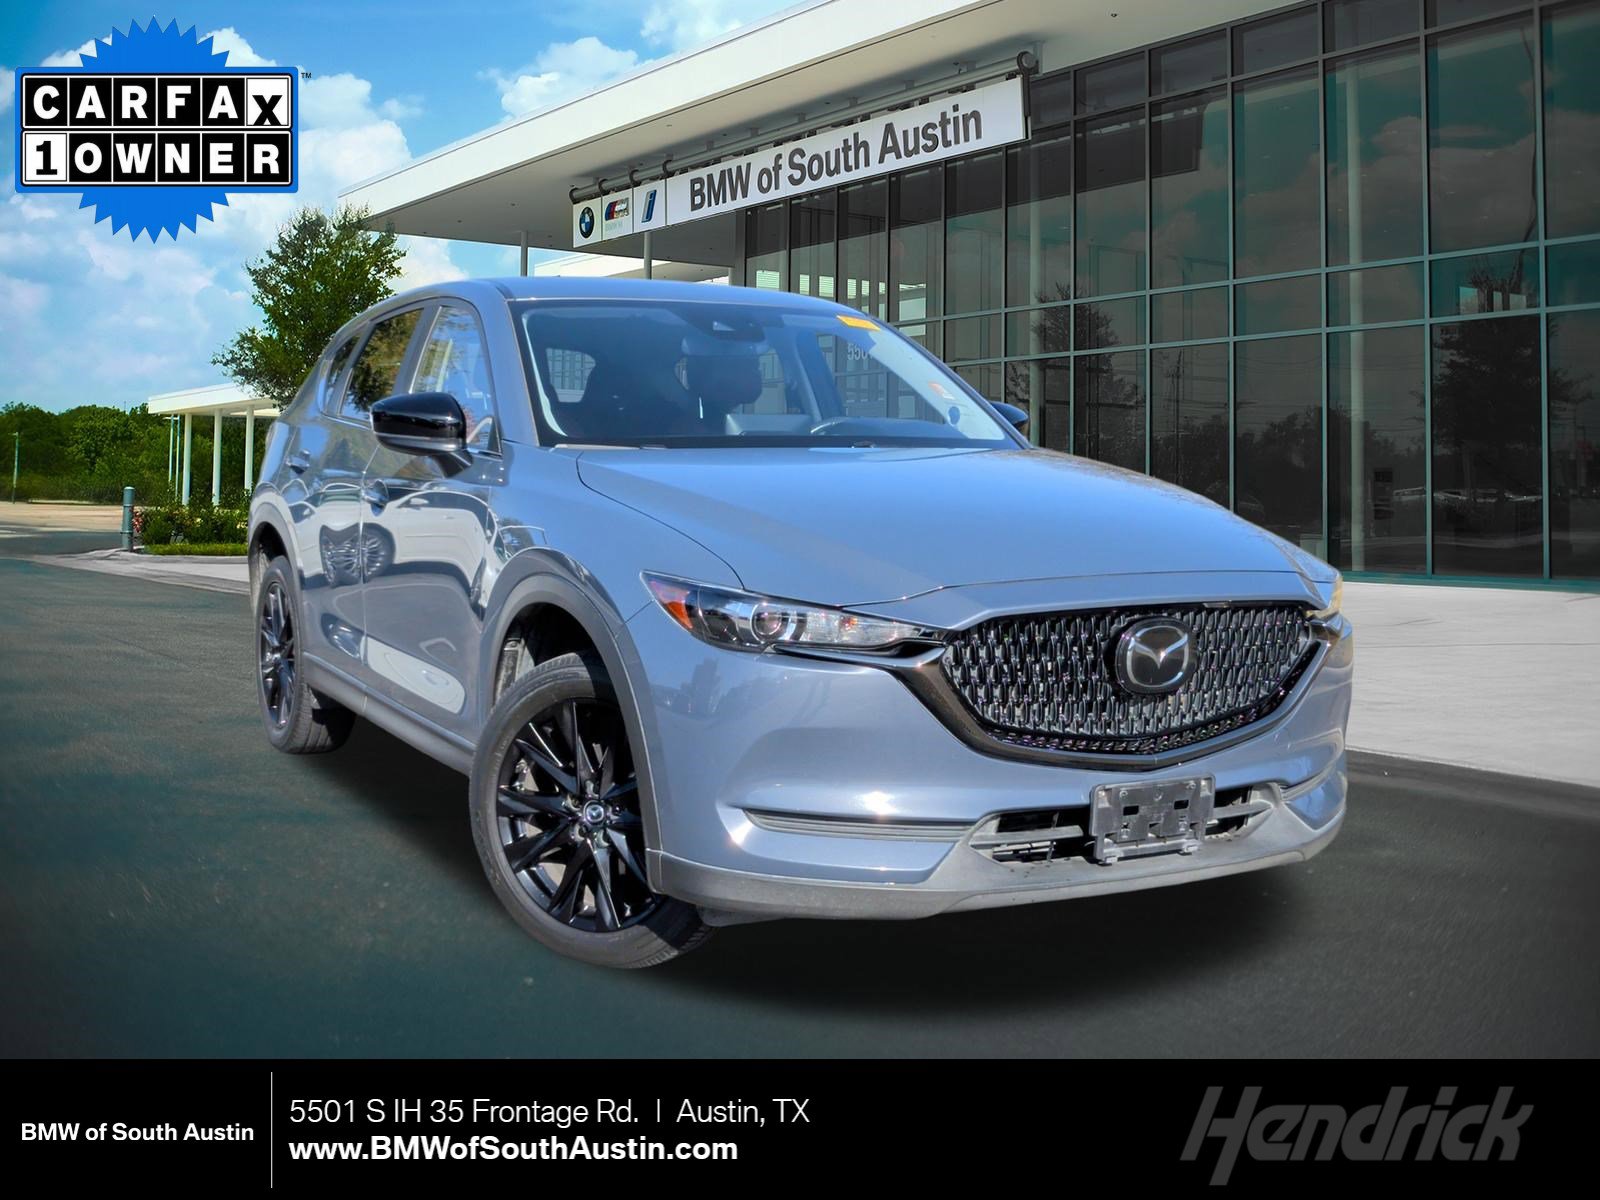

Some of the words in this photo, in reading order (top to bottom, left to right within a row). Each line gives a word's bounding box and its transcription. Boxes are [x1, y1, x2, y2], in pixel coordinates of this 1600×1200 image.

[690, 162, 752, 212] BMW
[757, 153, 783, 194] of
[787, 132, 871, 186] South
[878, 104, 983, 164] Austin
